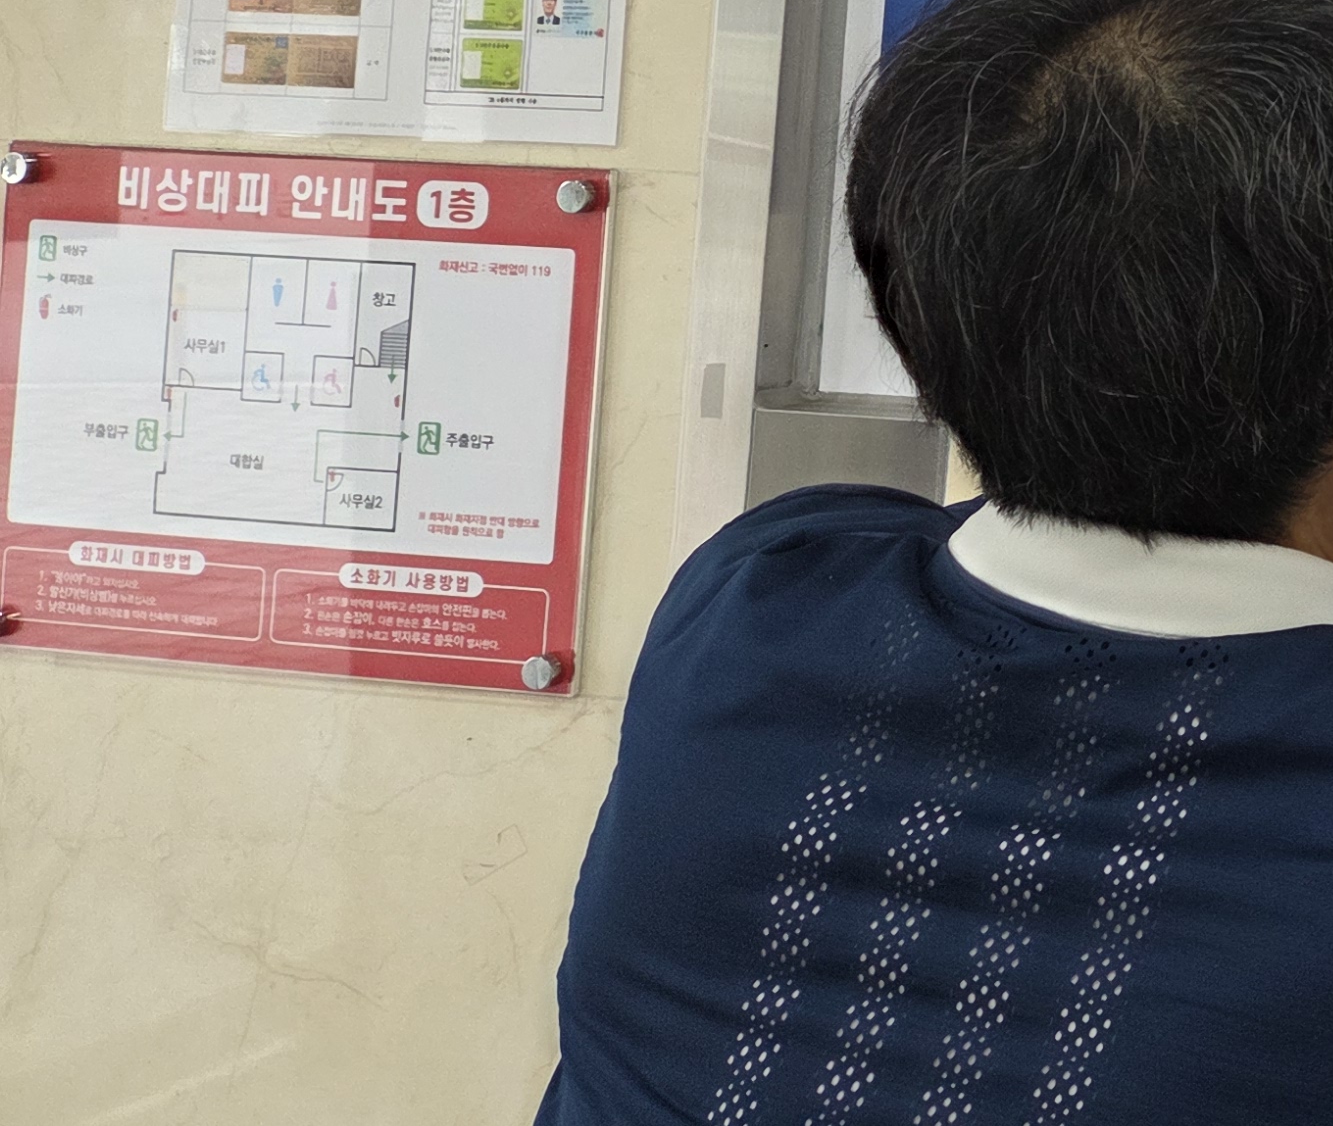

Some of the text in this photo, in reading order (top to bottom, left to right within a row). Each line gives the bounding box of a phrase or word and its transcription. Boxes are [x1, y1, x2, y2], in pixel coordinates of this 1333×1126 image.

[118, 166, 476, 224] 비상대피 안내도 1층
[531, 265, 552, 277] 119
[372, 291, 397, 308] 창고
[183, 338, 226, 355] 사무실1
[445, 432, 495, 450] 주출입구
[229, 454, 264, 470] 대합실
[339, 493, 383, 510] 사무실2
[80, 545, 191, 571] 화재시 대피방법
[350, 567, 469, 593] 소화기 사용방법
